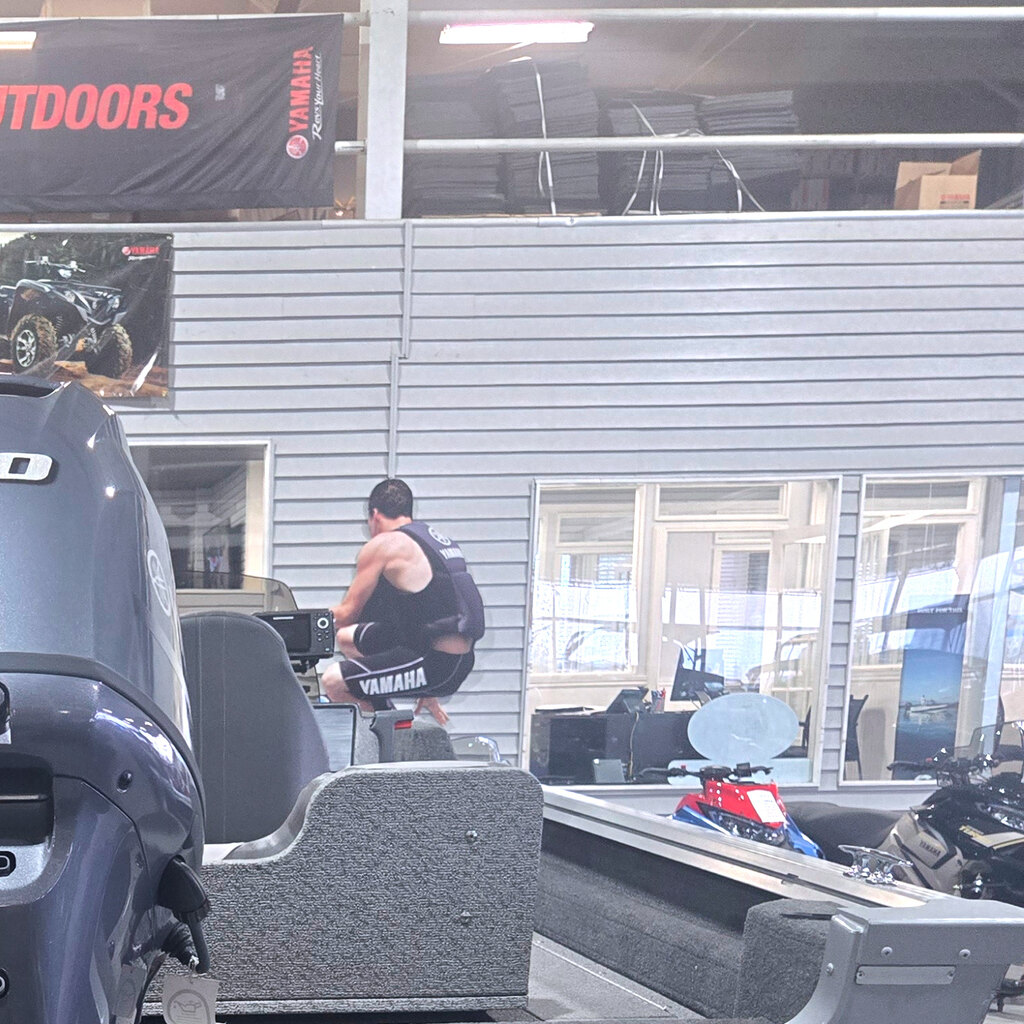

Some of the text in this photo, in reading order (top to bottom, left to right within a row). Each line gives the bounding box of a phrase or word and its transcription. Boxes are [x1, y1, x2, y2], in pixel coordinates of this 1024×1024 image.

[288, 46, 313, 133] YAMAHA
[314, 82, 324, 106] Your
[312, 106, 322, 140] Revs
[359, 666, 427, 696] YAMAHA
[919, 840, 942, 858] YAMAHA
